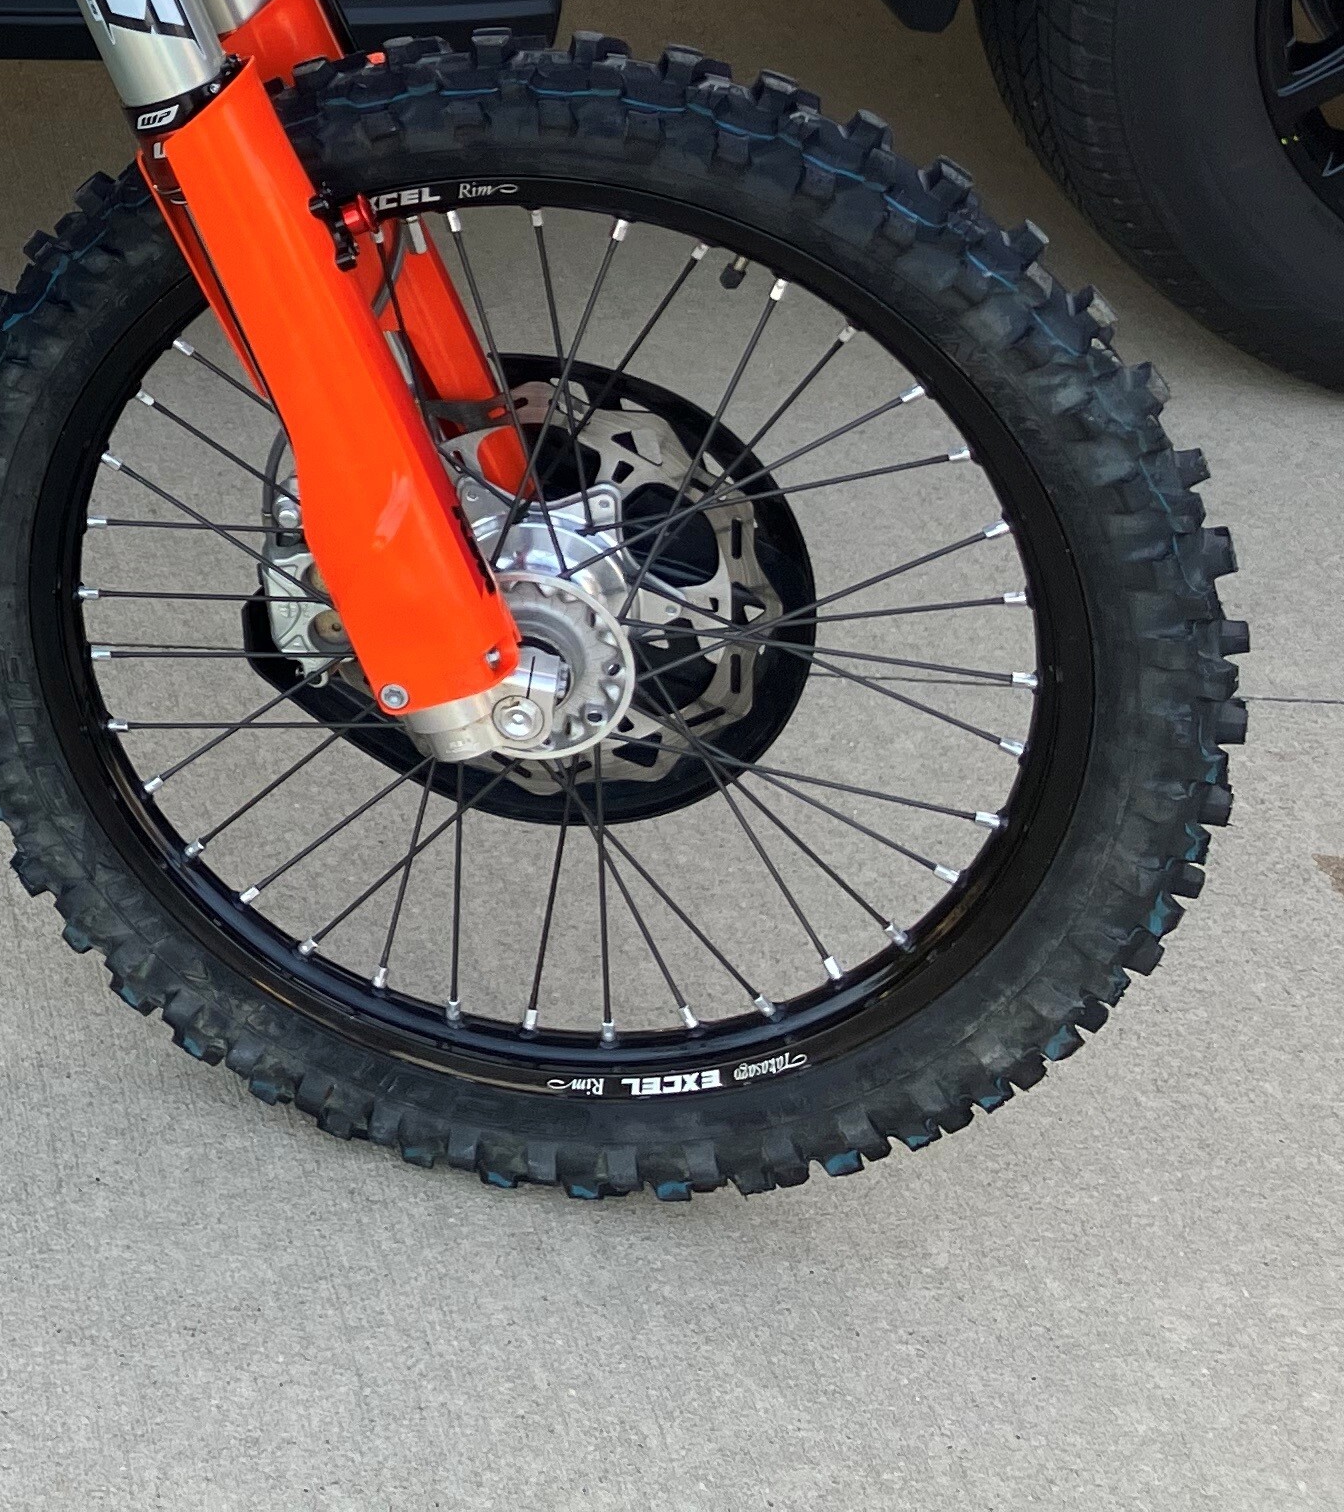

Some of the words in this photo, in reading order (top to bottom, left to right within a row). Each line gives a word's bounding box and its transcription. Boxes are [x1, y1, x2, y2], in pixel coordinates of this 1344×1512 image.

[140, 109, 171, 126] WP
[368, 187, 441, 214] XCEL
[458, 182, 512, 199] Rim
[734, 1052, 808, 1081] Takasago
[549, 1078, 605, 1096] Rim
[621, 1069, 723, 1096] EXCEL
